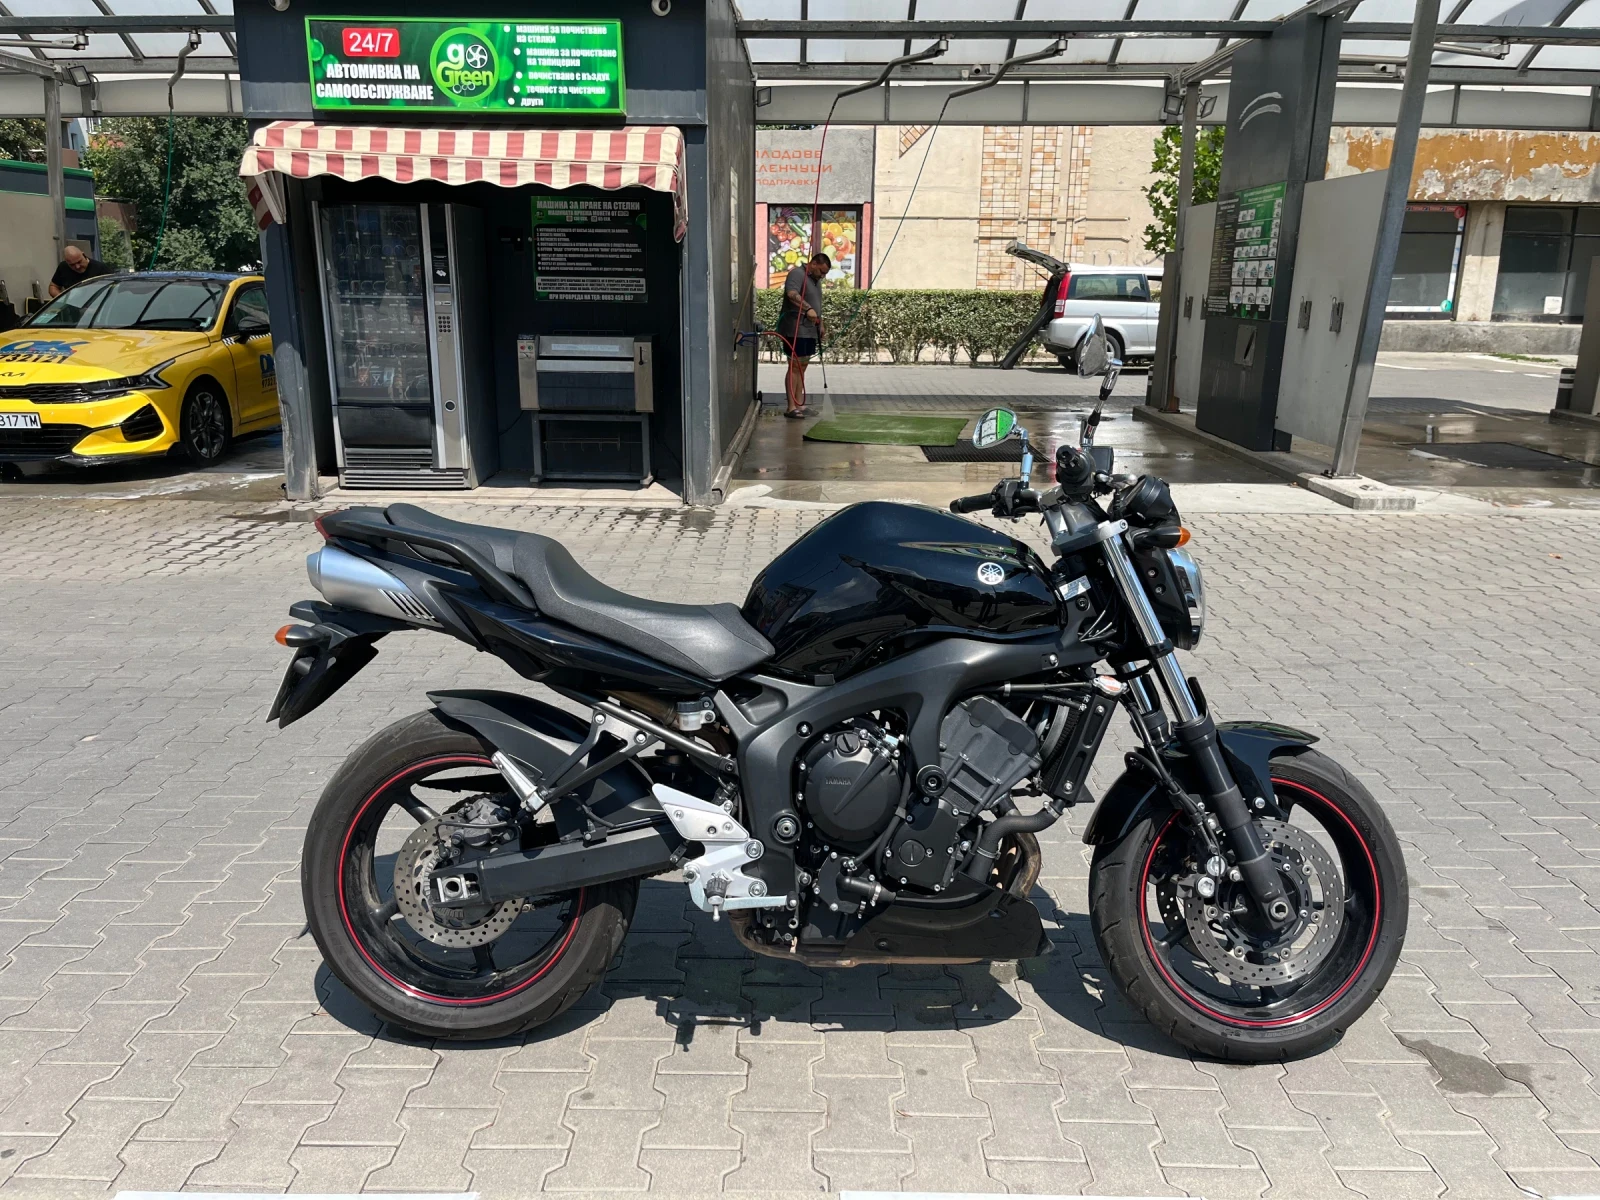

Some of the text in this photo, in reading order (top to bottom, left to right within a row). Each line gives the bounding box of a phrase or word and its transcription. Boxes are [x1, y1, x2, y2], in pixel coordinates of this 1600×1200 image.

[349, 32, 393, 53] 24/7
[326, 63, 420, 80] АВТОМИВКА НА
[436, 68, 494, 88] Green
[316, 83, 434, 100] САМООБСЛУЖВАНЕ
[536, 201, 640, 211] МАШИНА ЗА ПРАНЕ НА СТЕЛКИ
[21, 415, 39, 427] TM
[824, 776, 853, 786] YAMAHA
